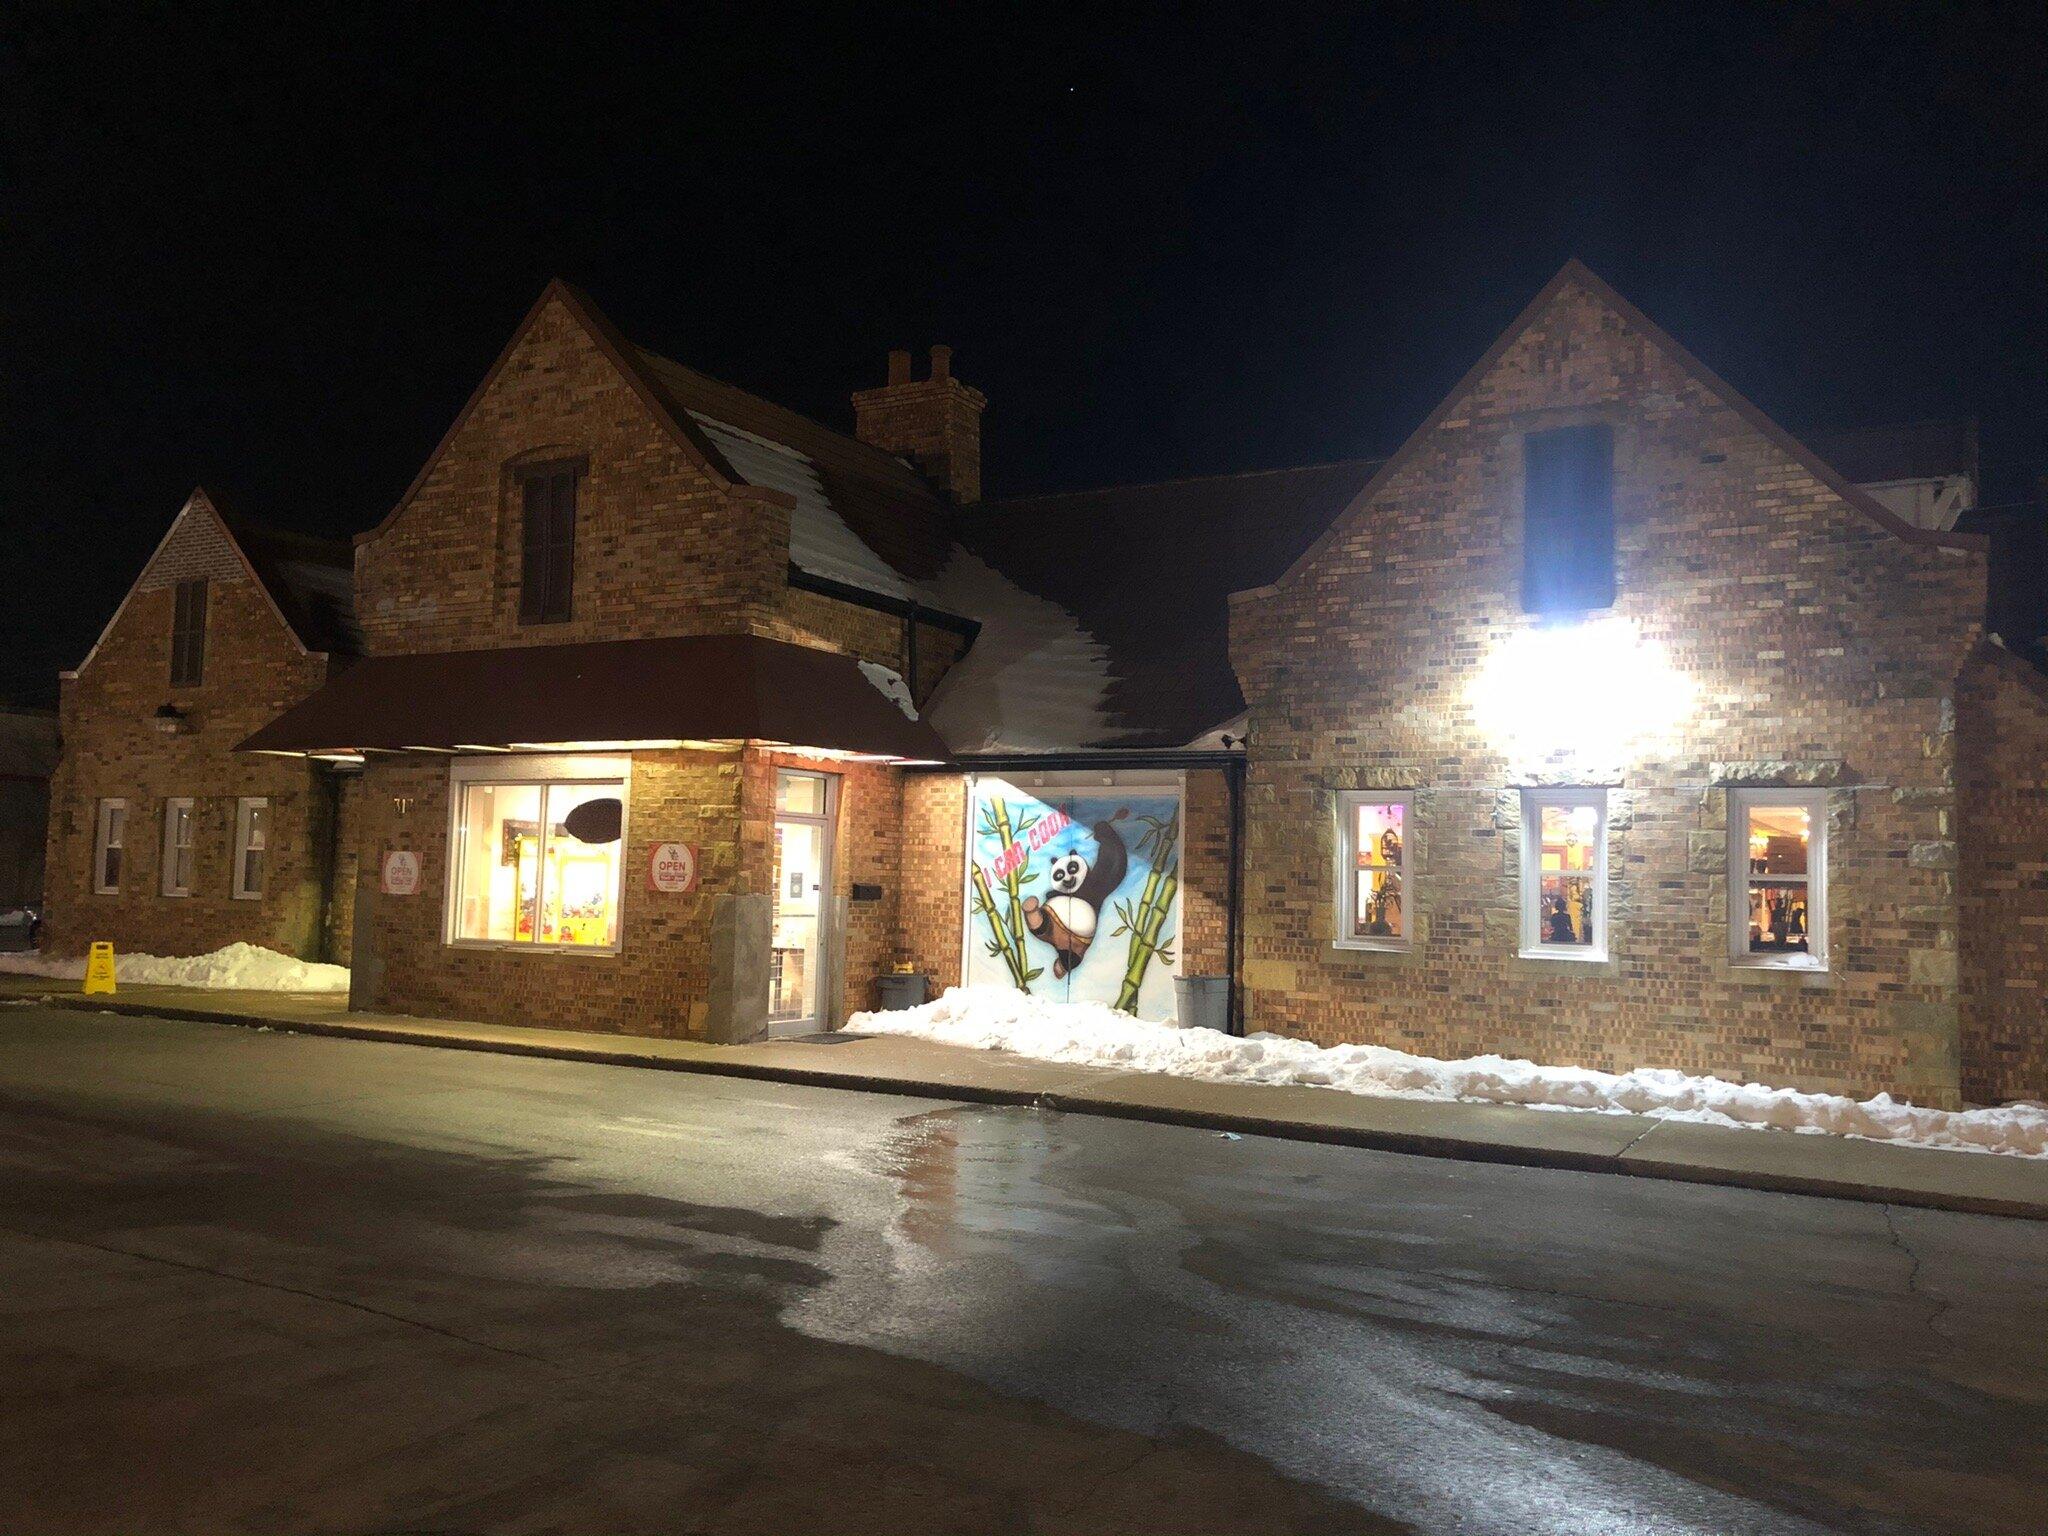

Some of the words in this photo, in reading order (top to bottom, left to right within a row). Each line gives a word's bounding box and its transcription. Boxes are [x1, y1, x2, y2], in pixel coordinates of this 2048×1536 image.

[983, 867, 992, 888] I
[1028, 803, 1071, 851] COOK
[391, 866, 413, 876] OPEN
[659, 861, 686, 871] OPEN
